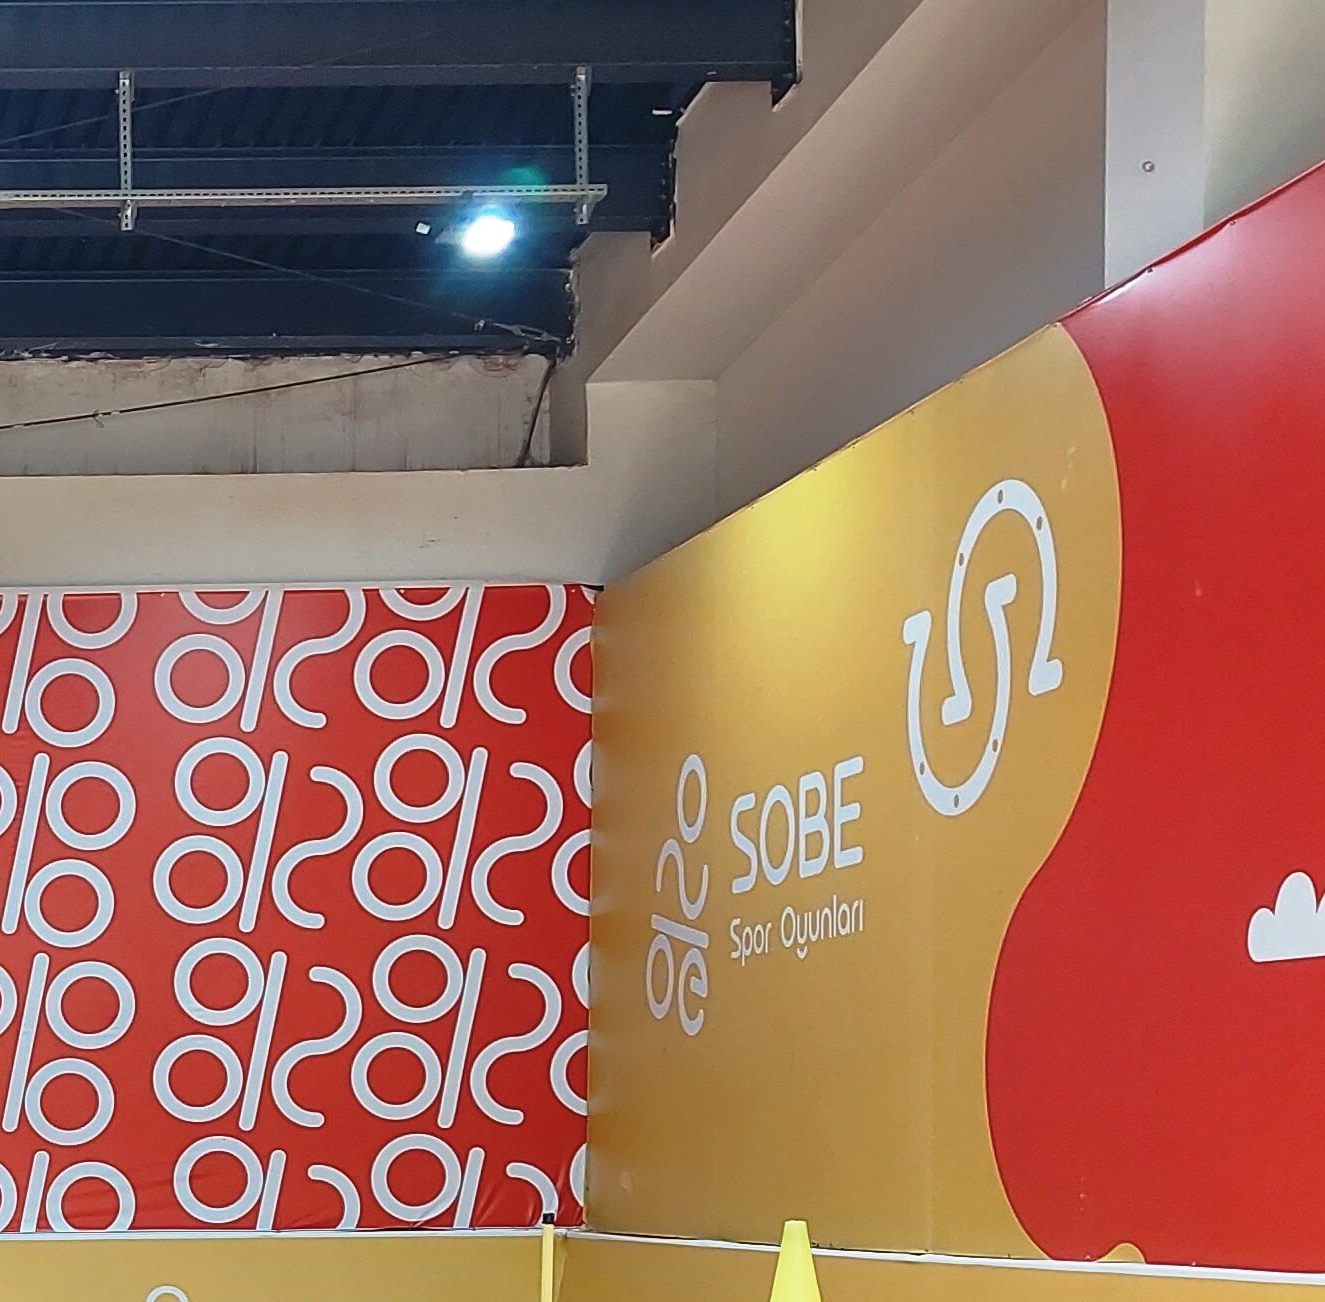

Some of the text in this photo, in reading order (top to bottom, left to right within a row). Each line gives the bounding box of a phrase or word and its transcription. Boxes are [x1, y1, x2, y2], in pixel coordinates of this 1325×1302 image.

[729, 754, 865, 895] SOBE
[729, 894, 865, 967] Spor Oyunları
